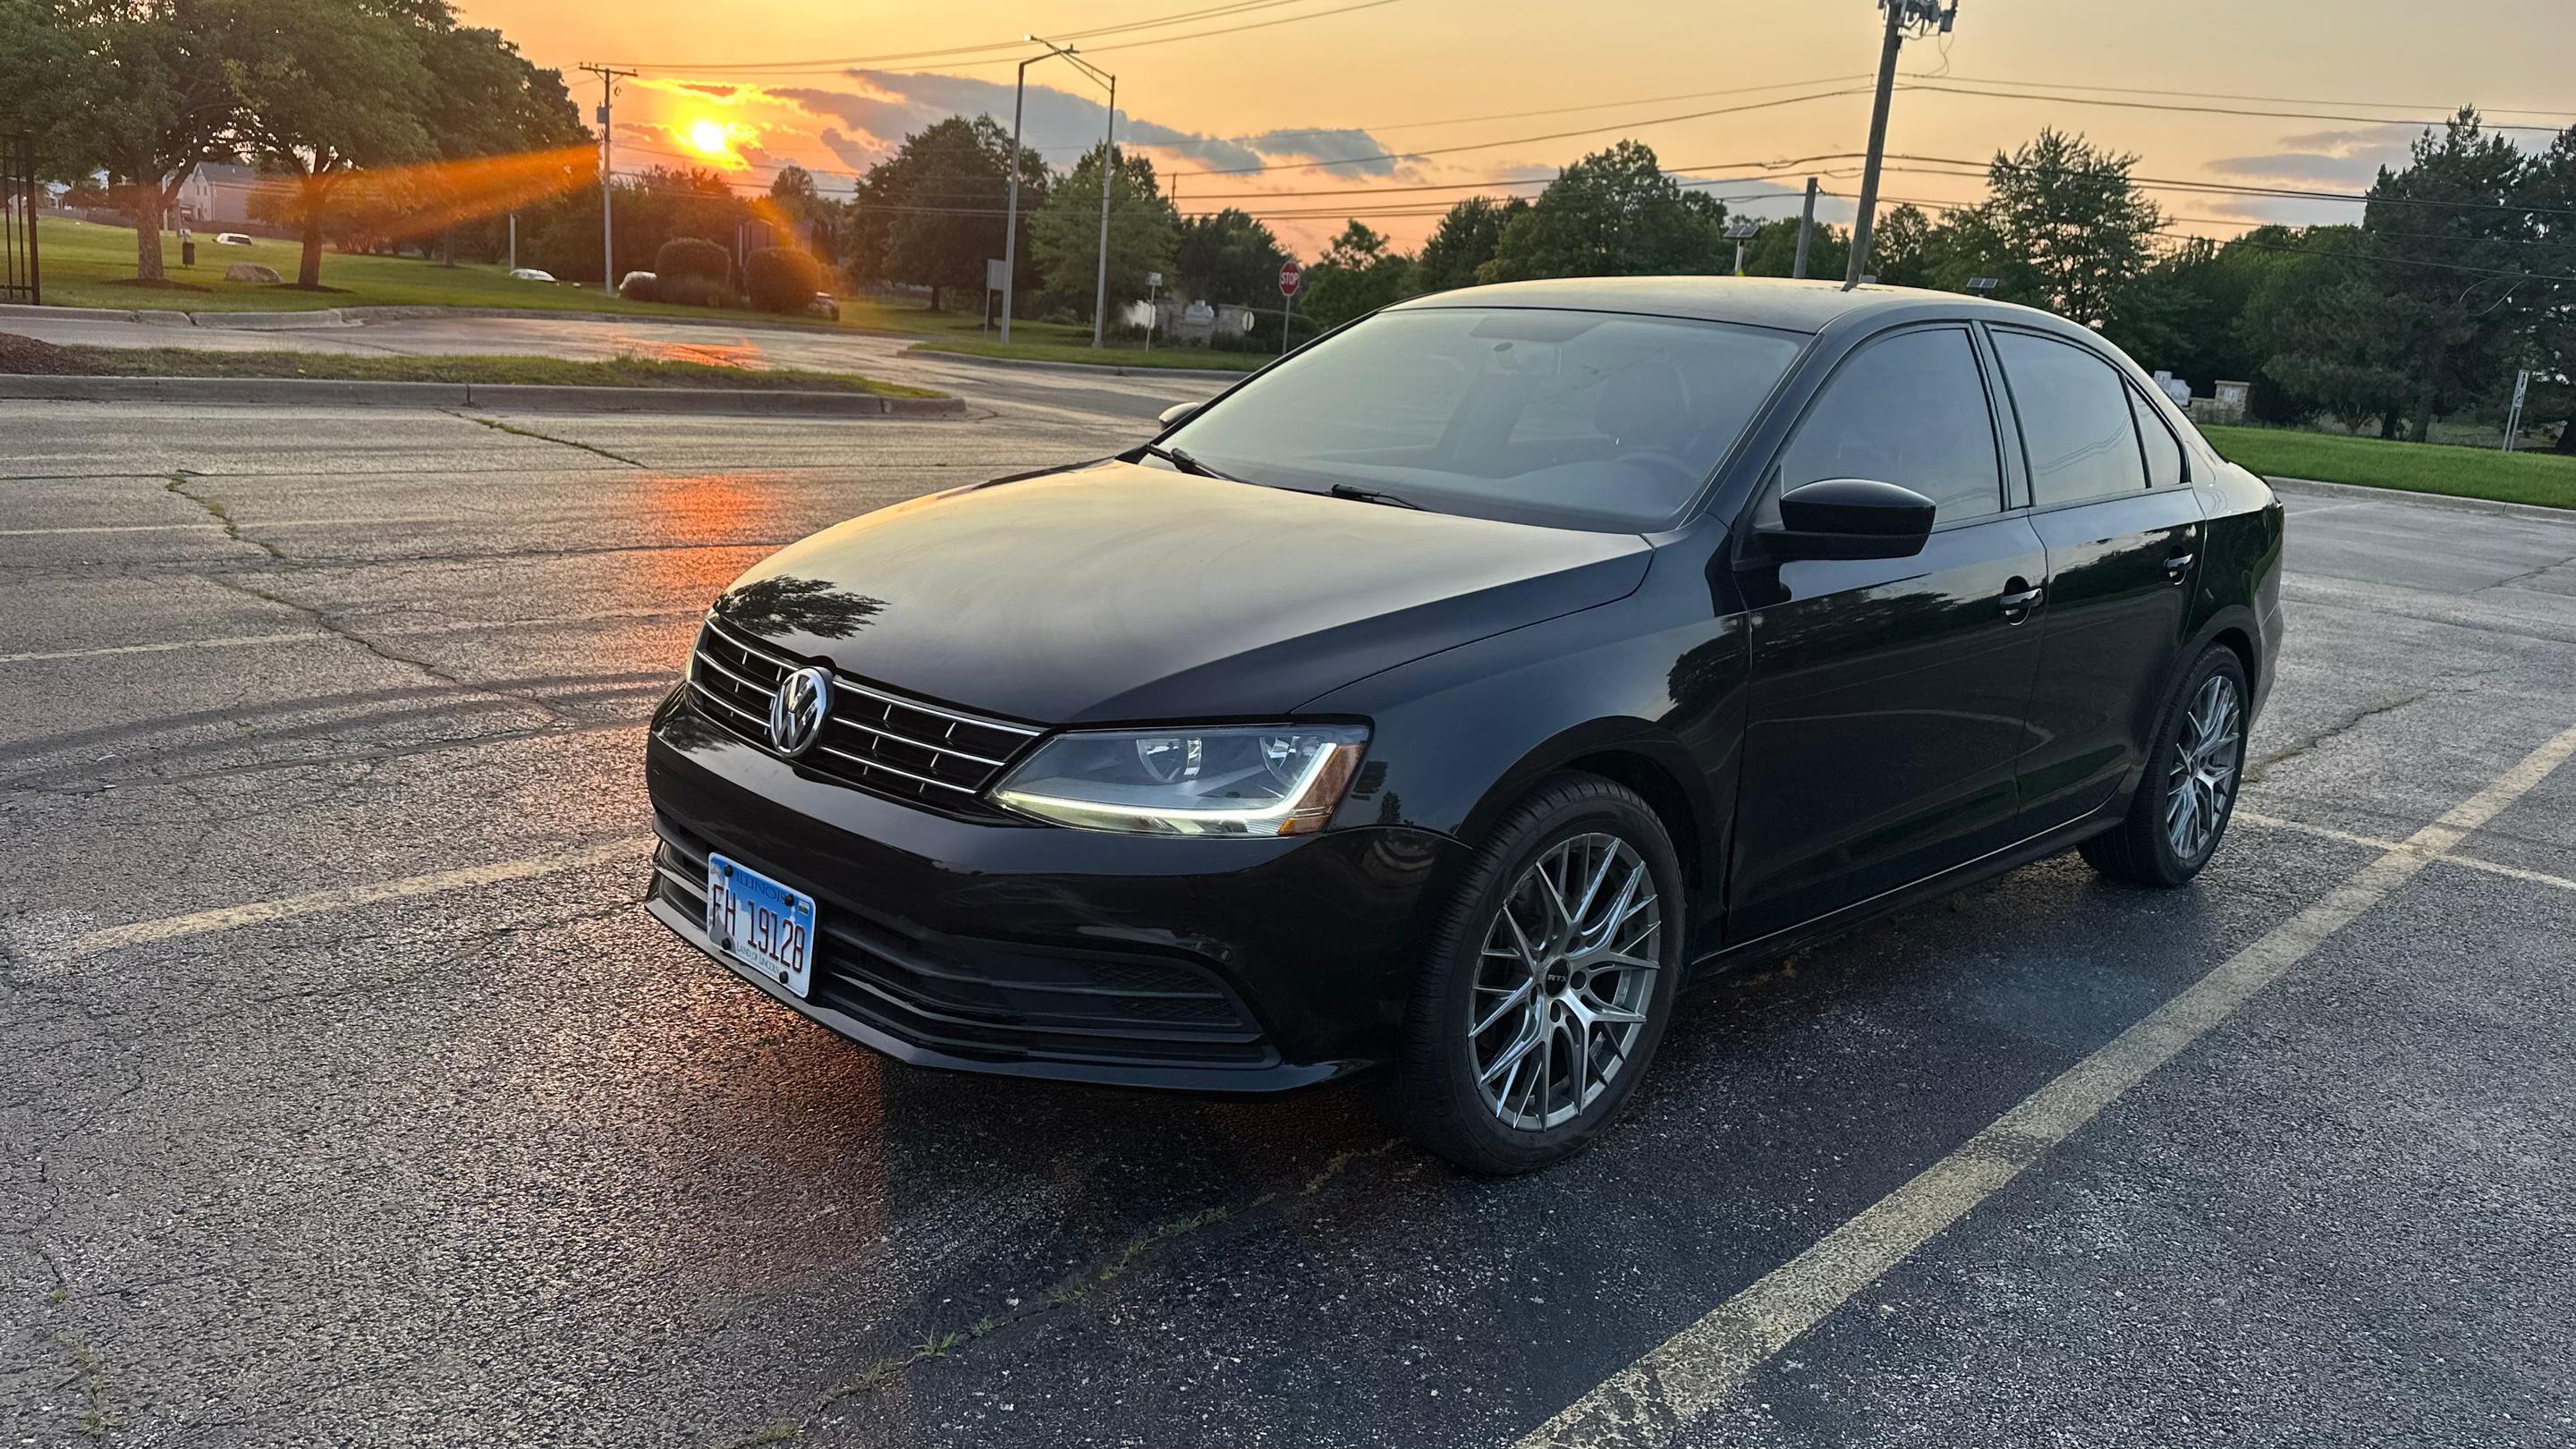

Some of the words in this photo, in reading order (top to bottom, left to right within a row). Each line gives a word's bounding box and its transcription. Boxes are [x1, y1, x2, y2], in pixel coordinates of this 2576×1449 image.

[1281, 272, 1299, 284] STOP
[712, 884, 736, 936] FH
[748, 901, 805, 973] 19128
[736, 940, 751, 958] LAND
[752, 951, 758, 961] OF
[1547, 974, 1567, 982] RTX
